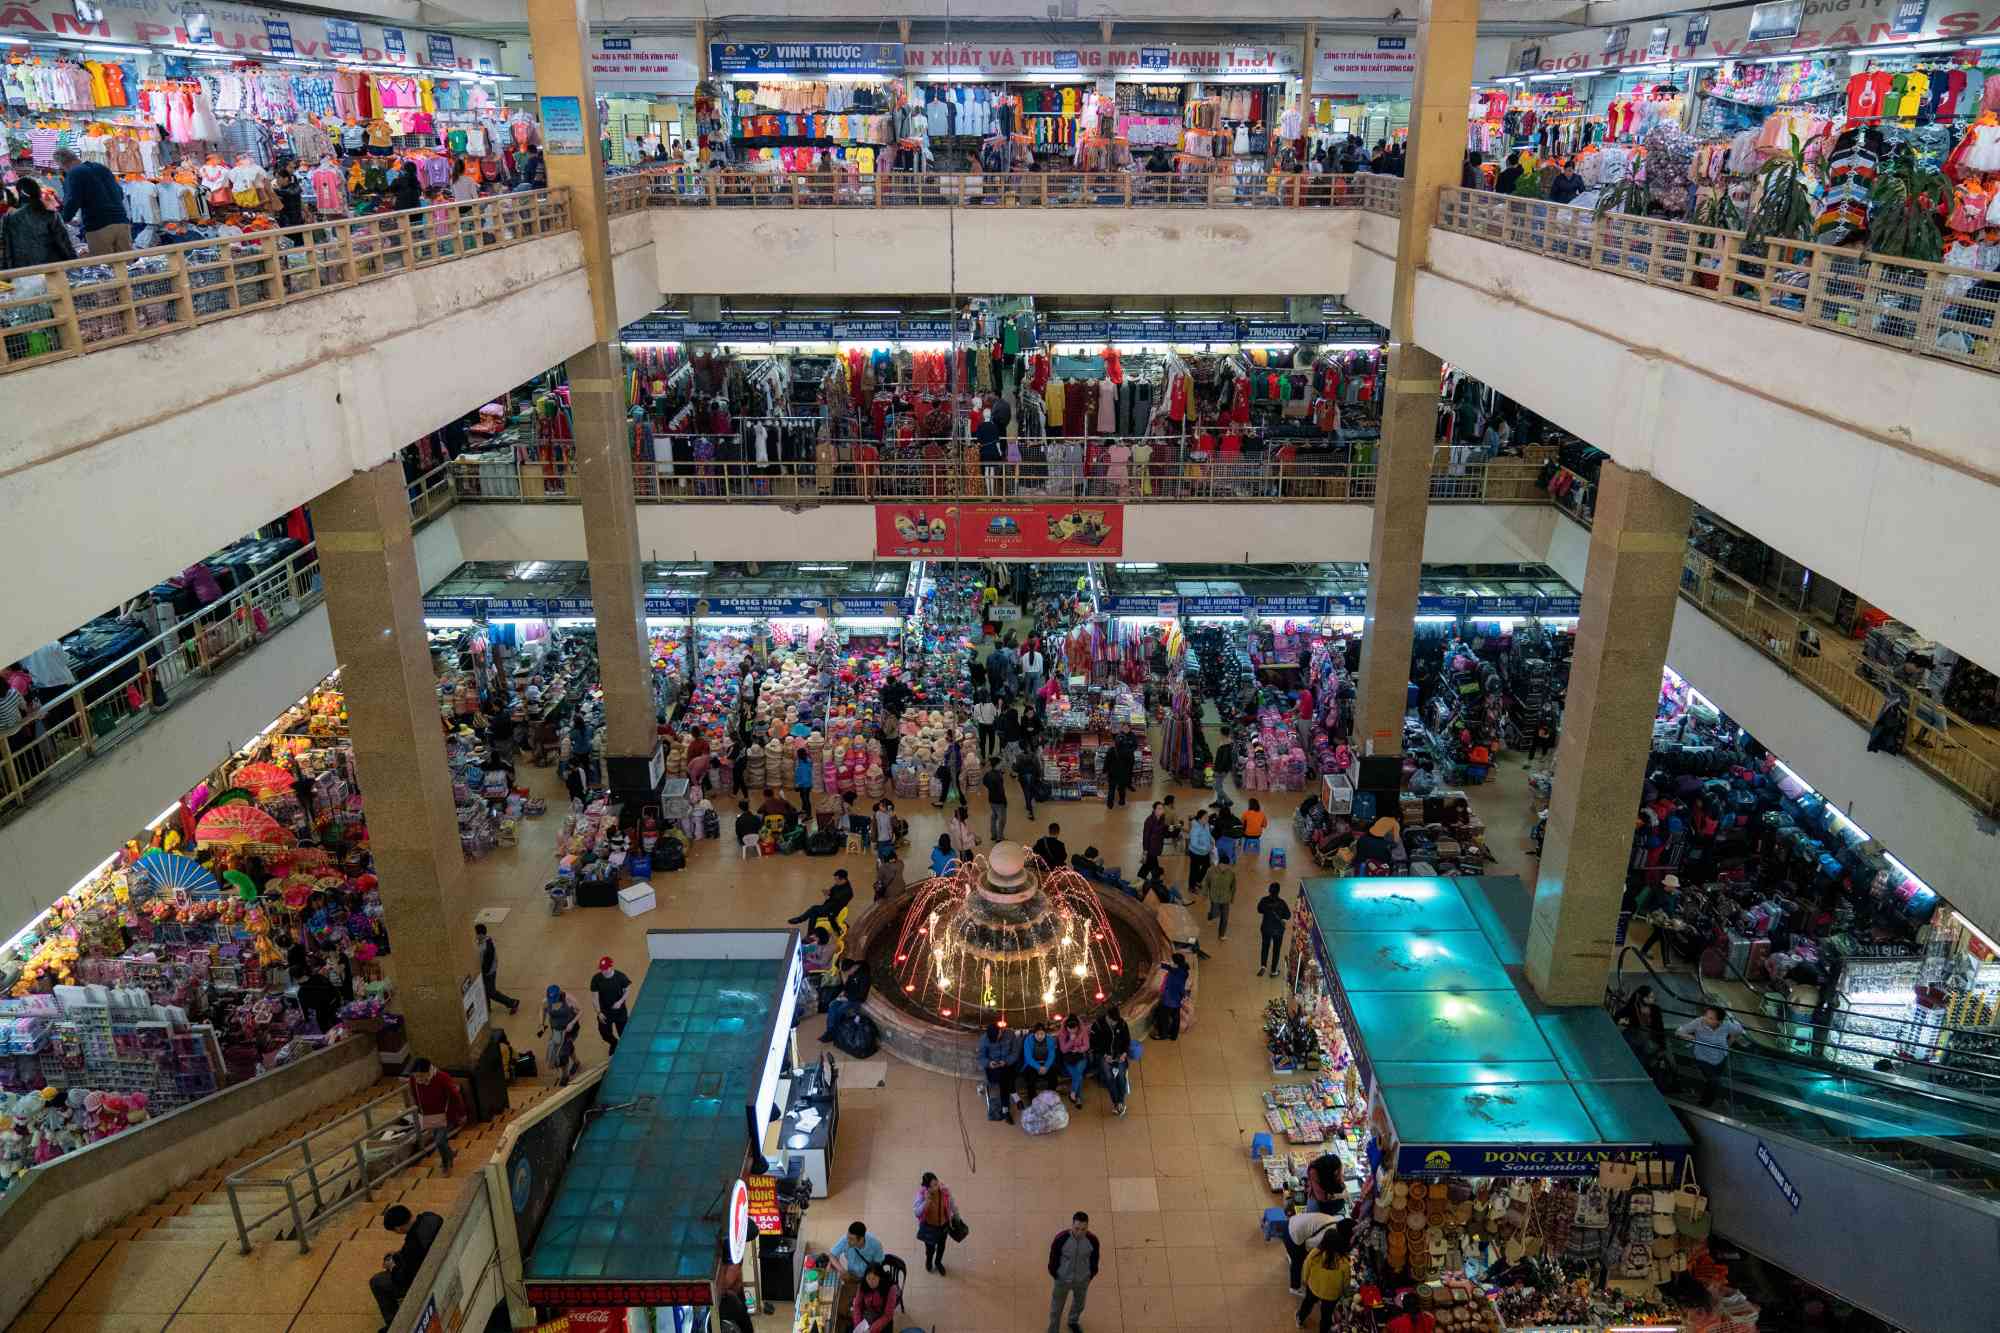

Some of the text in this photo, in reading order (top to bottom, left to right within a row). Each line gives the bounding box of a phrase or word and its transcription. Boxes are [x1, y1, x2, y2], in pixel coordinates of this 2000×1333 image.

[931, 46, 983, 66] XUẤT
[989, 48, 1015, 66] VÀ
[1021, 49, 1101, 66] THƯNG
[1109, 50, 1140, 69] MẠ
[1484, 1151, 1547, 1163] DONG
[1551, 1151, 1610, 1163] XUAN
[1501, 1162, 1586, 1172] Souvenirs
